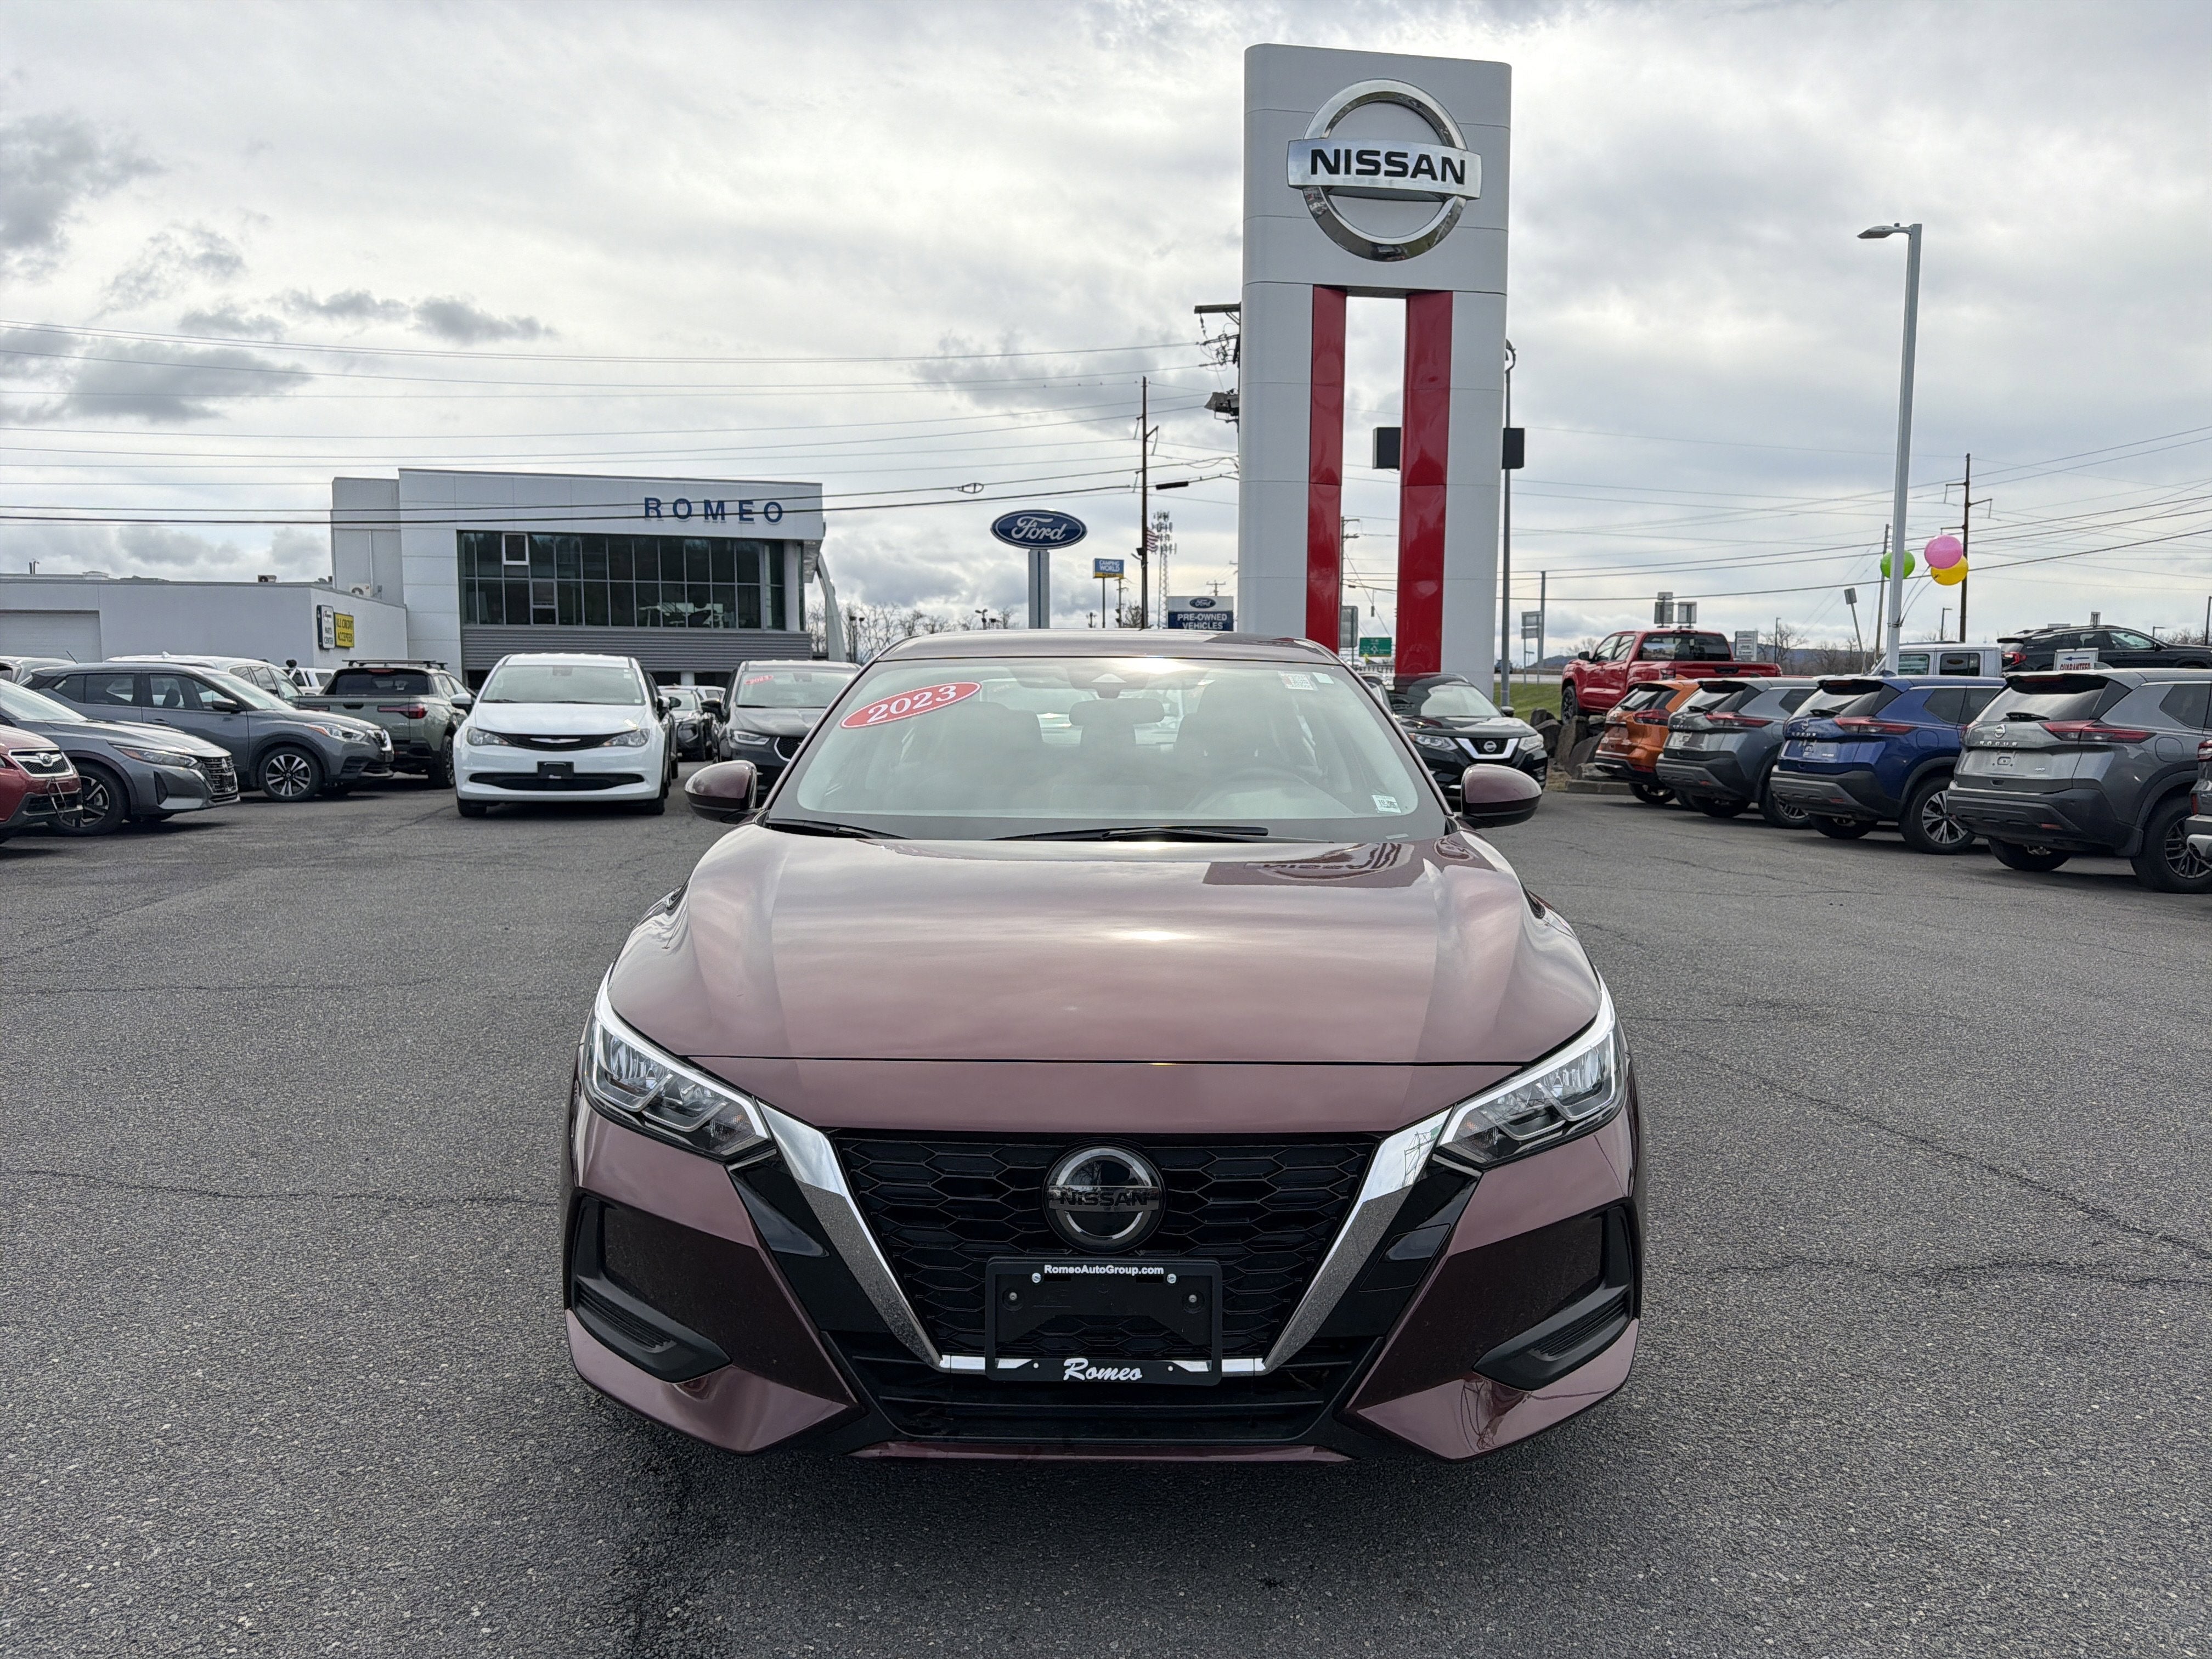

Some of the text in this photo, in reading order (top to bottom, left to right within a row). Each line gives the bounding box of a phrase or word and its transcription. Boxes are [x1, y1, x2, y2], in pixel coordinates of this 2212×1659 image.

[1311, 149, 1465, 185] NISSAN
[644, 497, 783, 523] ROMEO
[1011, 516, 1068, 540] Ford
[1177, 613, 1228, 621] PRE-OWNED
[342, 619, 353, 630] CREDIT
[1182, 622, 1223, 630] VEHICLES
[337, 631, 353, 642] ACCEPTED
[2059, 662, 2091, 671] GUARANTEED
[867, 685, 957, 724] 2023
[1059, 1192, 1148, 1206] NISSAN
[1044, 1265, 1164, 1277] RomeoAutoGroup.com
[1063, 1357, 1143, 1381] Romeo
